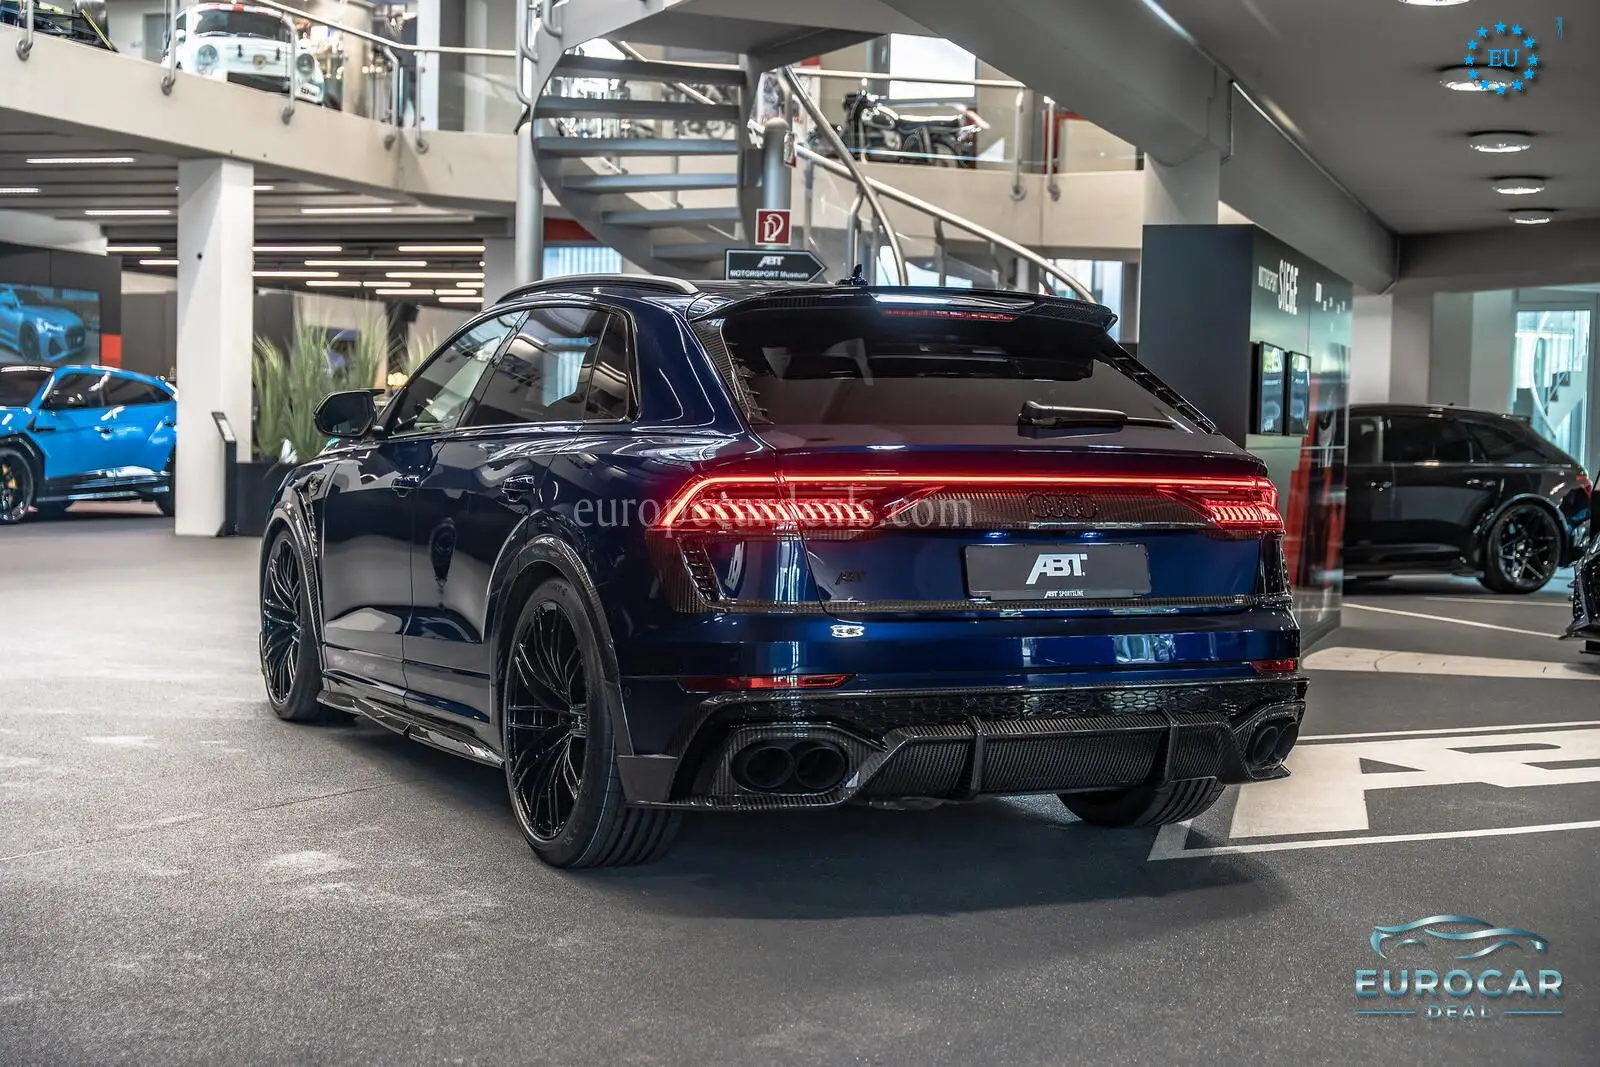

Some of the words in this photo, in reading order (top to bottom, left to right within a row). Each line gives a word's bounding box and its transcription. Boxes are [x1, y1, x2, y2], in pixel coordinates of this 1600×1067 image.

[757, 255, 785, 269] ABT
[729, 269, 780, 279] MOTORSPORT
[780, 270, 810, 279] Museum
[1043, 590, 1059, 599] ABT
[1058, 590, 1085, 598] SPORTSLINE
